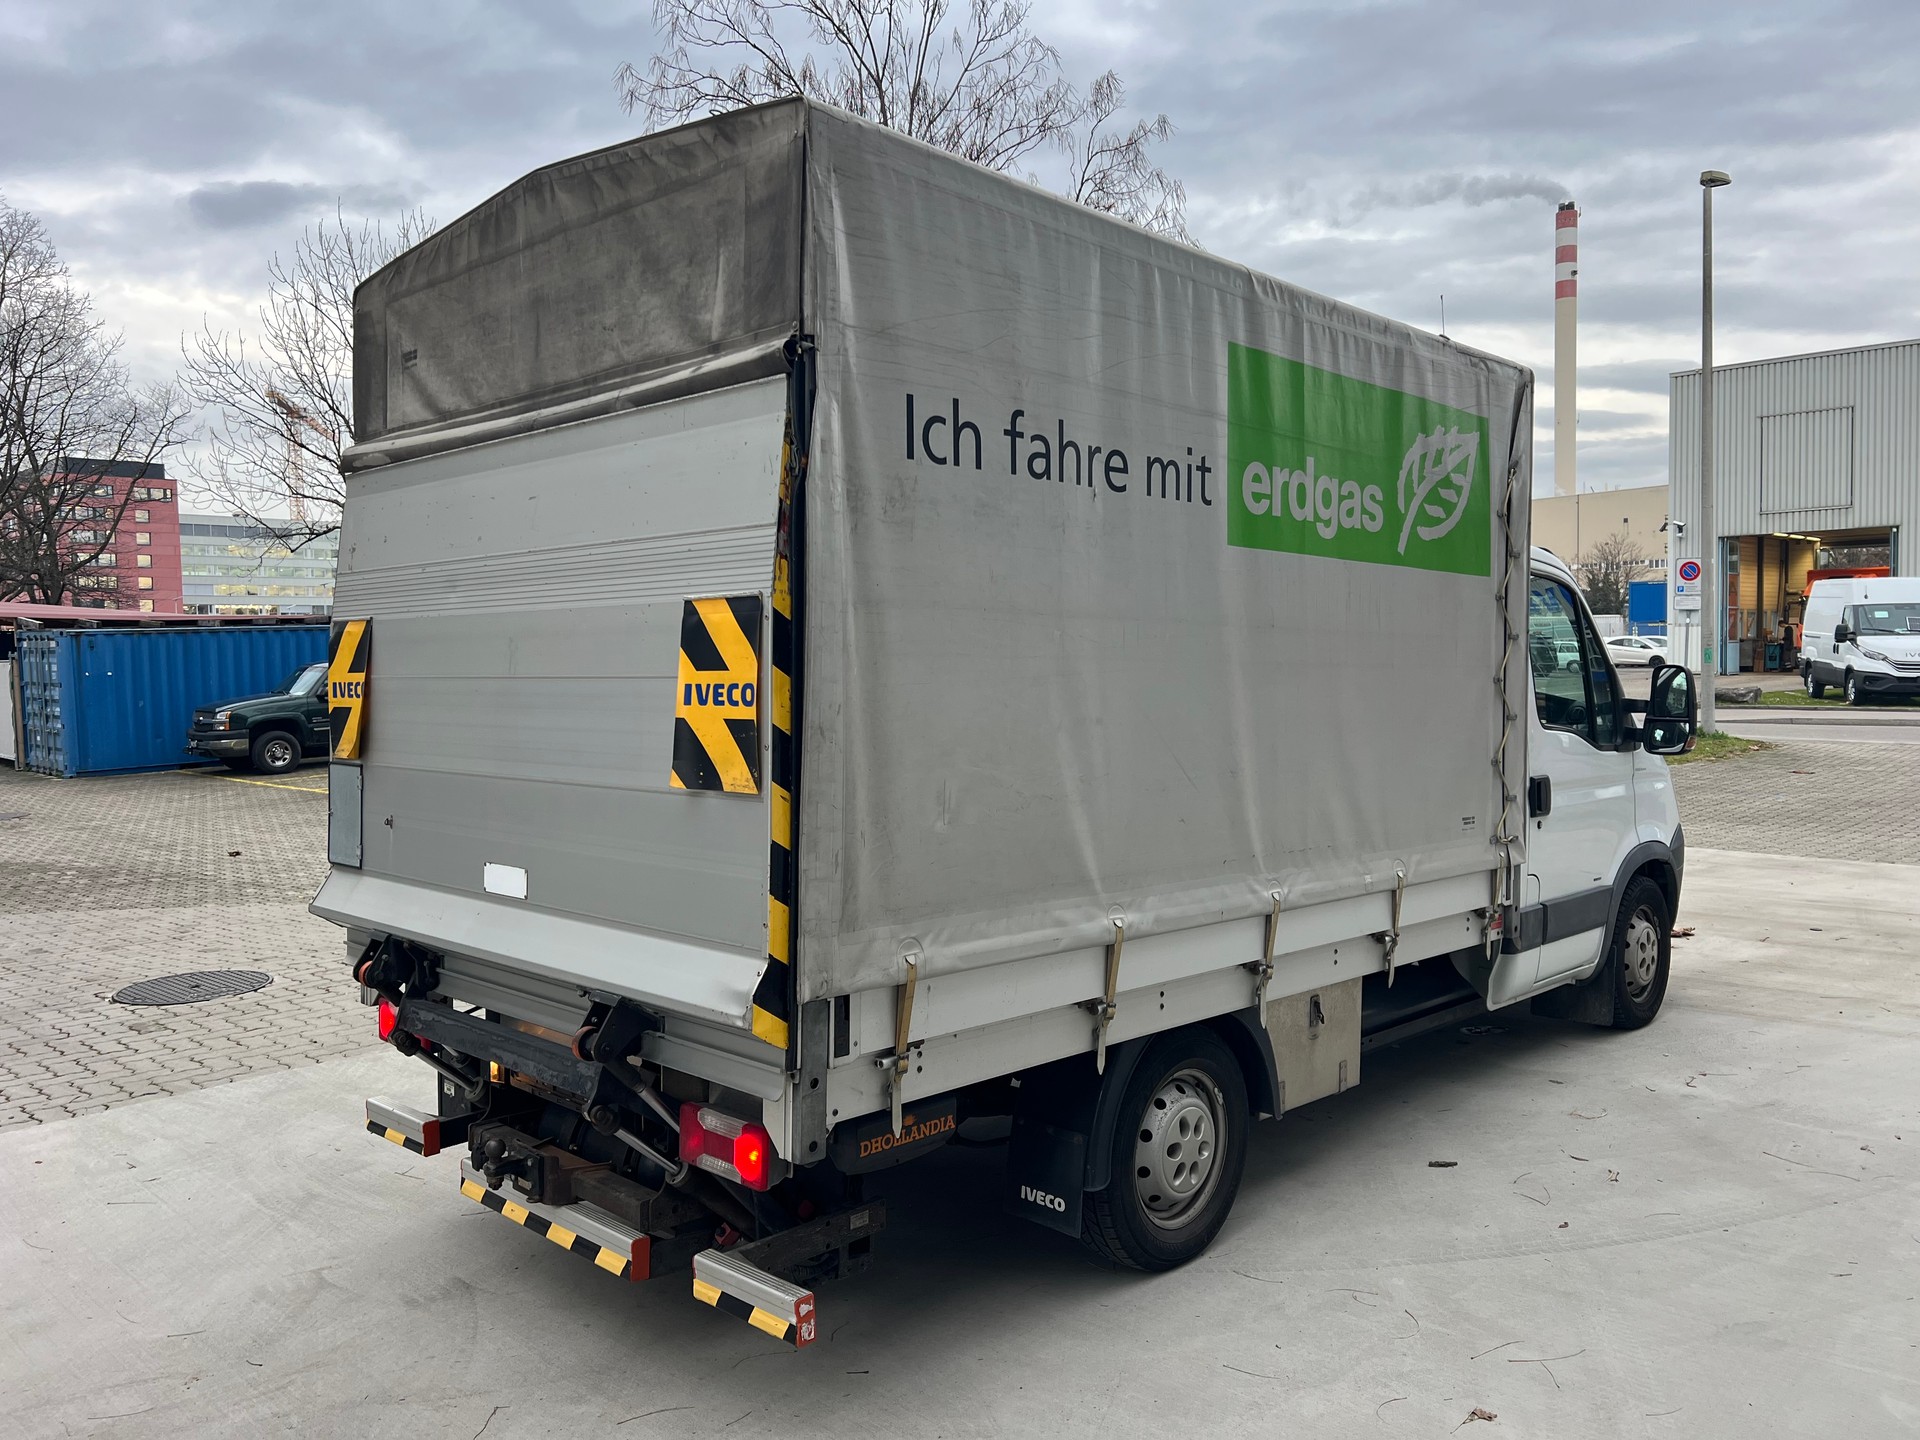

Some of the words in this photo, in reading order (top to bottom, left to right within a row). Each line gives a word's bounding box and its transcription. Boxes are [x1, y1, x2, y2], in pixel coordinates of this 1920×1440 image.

[906, 393, 983, 470] Ich
[1003, 409, 1129, 493] fahre
[1146, 447, 1212, 506] mit
[1242, 456, 1384, 540] erdgas
[683, 683, 755, 707] IVECO
[860, 1115, 956, 1157] DHOLLANDIA
[1020, 1185, 1066, 1212] IVECO
